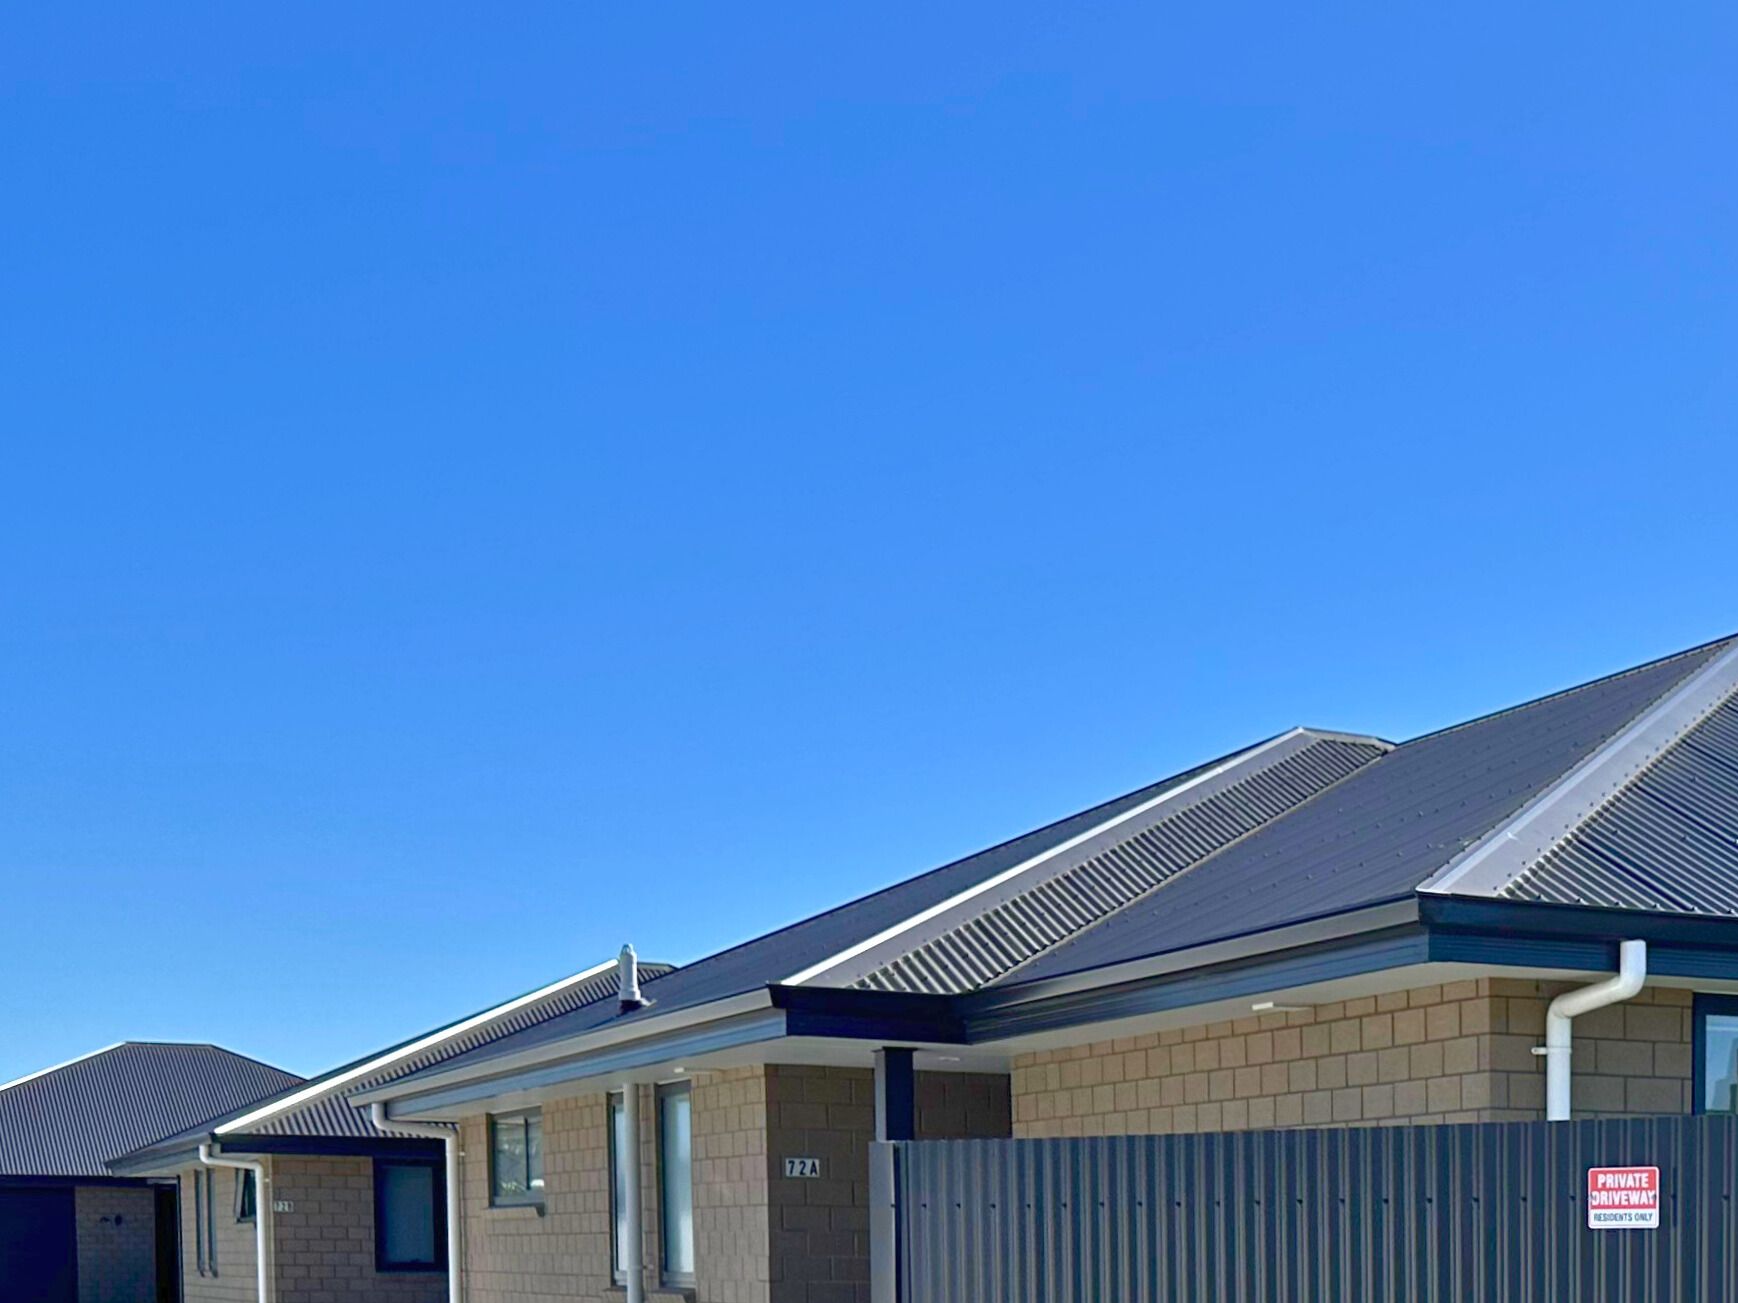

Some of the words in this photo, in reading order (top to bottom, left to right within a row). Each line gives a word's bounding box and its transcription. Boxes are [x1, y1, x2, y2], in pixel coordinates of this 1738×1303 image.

[788, 1160, 818, 1176] 72A
[1597, 1173, 1649, 1188] PRIVATE
[1592, 1190, 1656, 1205] DRIVEWAY
[1594, 1213, 1632, 1221] RESIDENTS
[1634, 1212, 1653, 1221] ONLY
